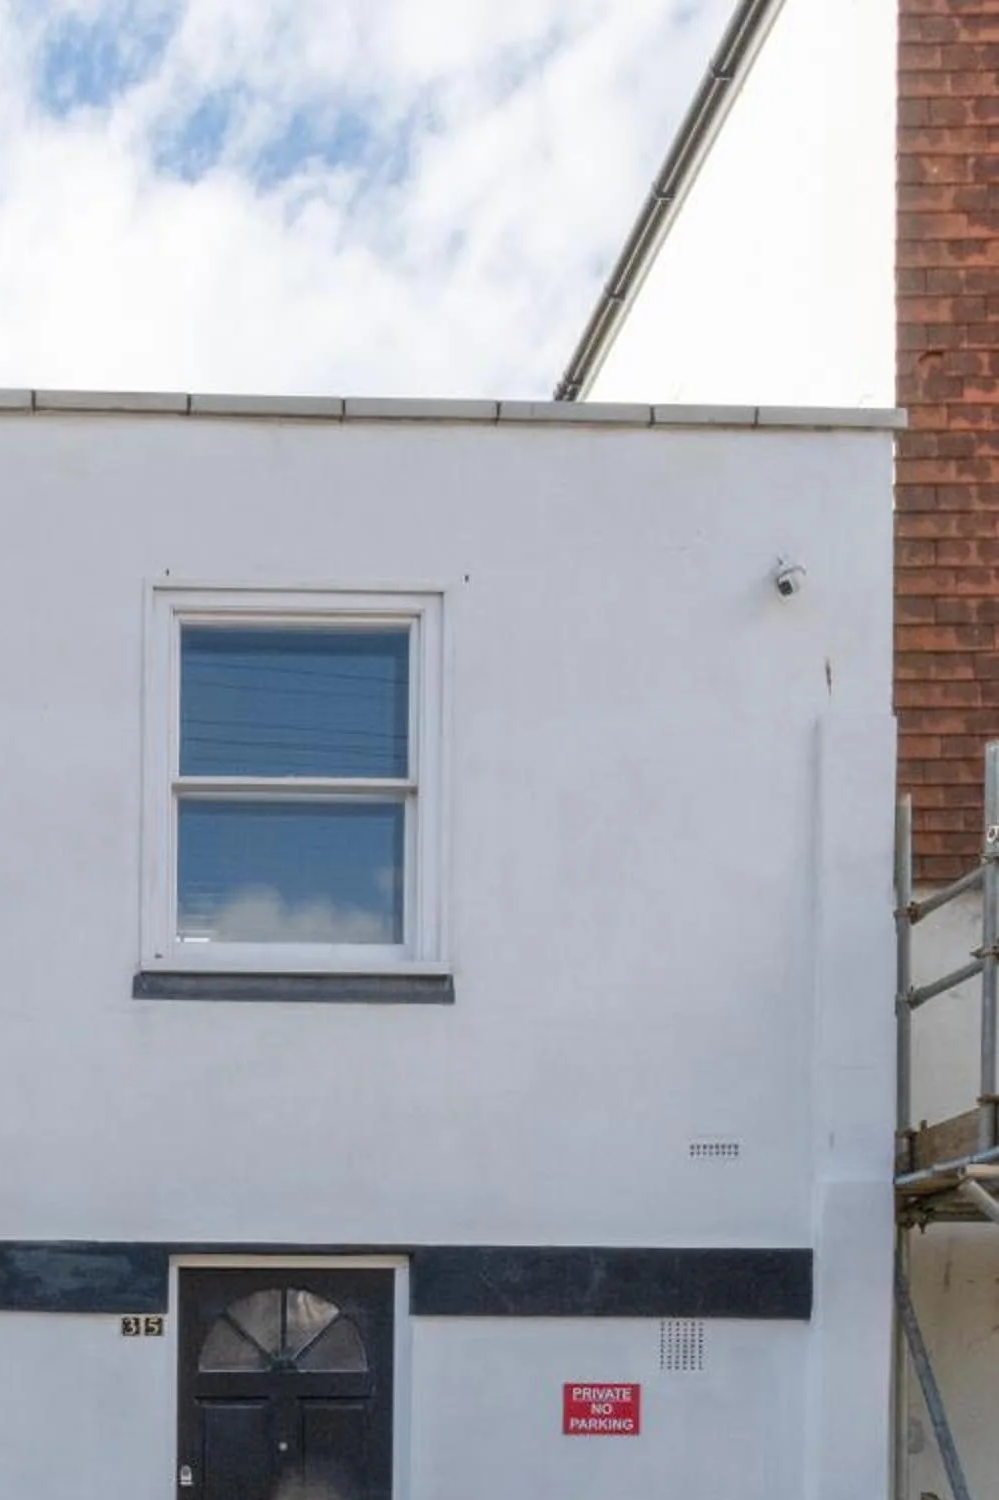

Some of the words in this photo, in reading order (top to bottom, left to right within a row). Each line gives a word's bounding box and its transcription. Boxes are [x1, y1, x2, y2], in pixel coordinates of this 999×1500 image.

[123, 1316, 161, 1336] 35
[572, 1387, 633, 1401] PRIVATE
[591, 1403, 613, 1415] NO
[569, 1417, 634, 1430] PARKING
